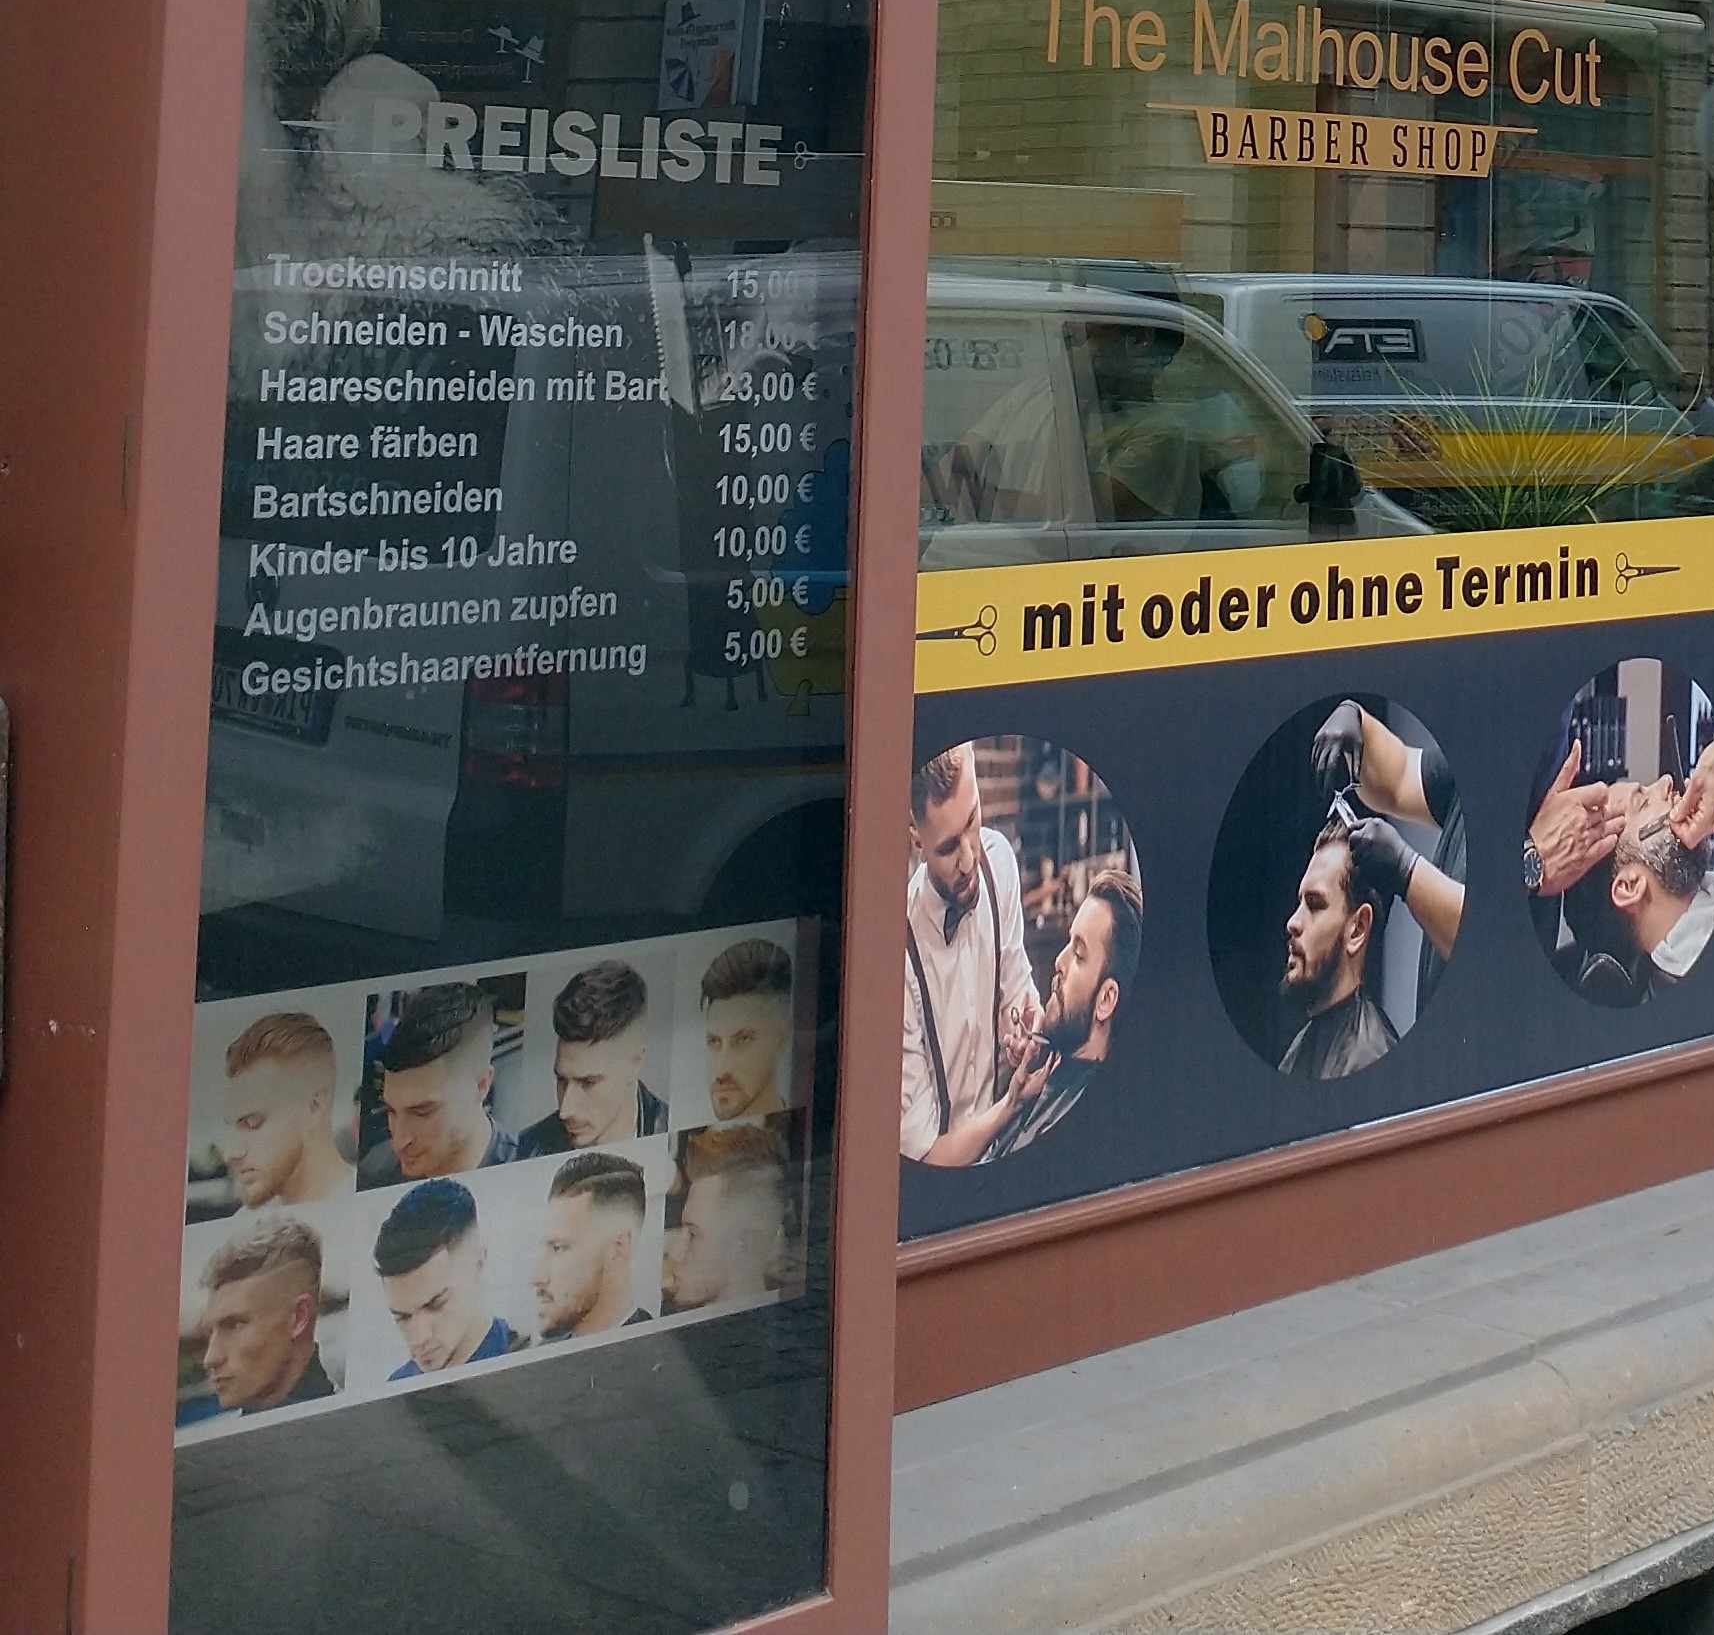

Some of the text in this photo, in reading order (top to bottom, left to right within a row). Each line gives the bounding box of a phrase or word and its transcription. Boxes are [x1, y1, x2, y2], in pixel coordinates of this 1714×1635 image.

[1509, 27, 1602, 108] Cut
[373, 101, 782, 186] PREISLISTE
[1210, 112, 1489, 174] BARBER SHOP
[266, 253, 523, 293] Trockenschnitt
[263, 311, 448, 347] Schneiden
[480, 314, 624, 349] Waschen
[260, 369, 535, 402] Haareschneiden
[547, 370, 596, 401] mit
[605, 370, 668, 401] Bart
[720, 371, 795, 407] 23,00
[256, 427, 359, 461] Haare
[370, 423, 478, 458] färben
[718, 422, 792, 457] 15,00
[252, 481, 503, 519] Bartschneiden
[715, 473, 791, 508] 10,00
[249, 541, 368, 578] Kinder
[378, 537, 428, 573] bis
[440, 535, 479, 569] 10
[488, 532, 579, 567] Jahre
[713, 526, 787, 561] 10,00
[243, 590, 500, 641] Augenbraunen
[510, 586, 618, 628] zupfen
[726, 575, 785, 612] 5,00
[1022, 544, 1600, 653] mit oder ohne Termin
[241, 638, 648, 696] Gesichtshaarentfernung
[724, 627, 783, 666] 5,00
